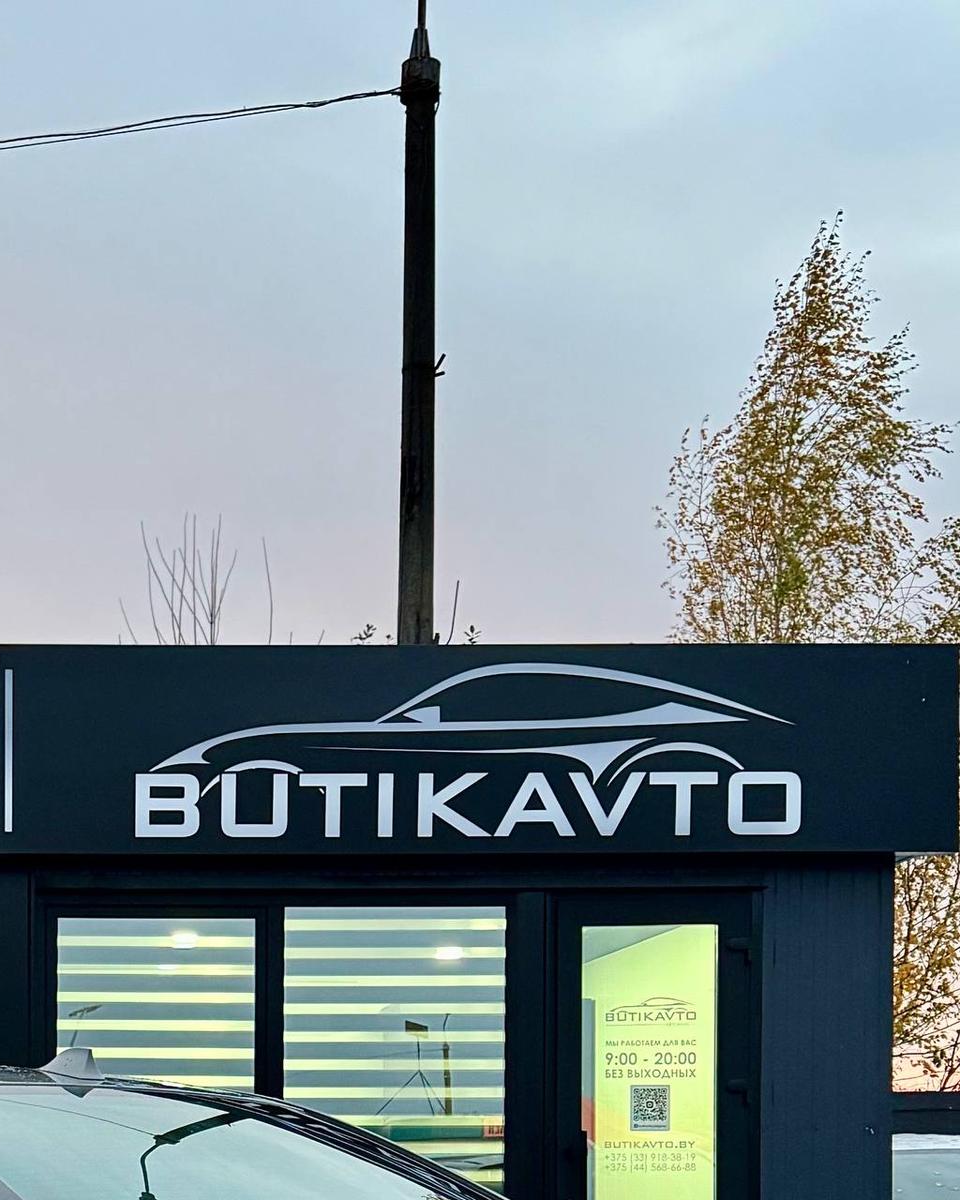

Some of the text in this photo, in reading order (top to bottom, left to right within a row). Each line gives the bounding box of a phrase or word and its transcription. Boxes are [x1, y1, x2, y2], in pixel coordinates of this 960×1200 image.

[135, 771, 802, 838] BUTIKAVTO
[605, 1011, 697, 1022] BUTIKAVTO
[605, 1052, 638, 1065] 9:00
[654, 1052, 697, 1065] 20:00
[605, 1068, 696, 1079] БЕЗ ВЫХОДНЫХ
[604, 1141, 696, 1149] BUTIKAVTO.BY
[604, 1153, 627, 1162] +375
[630, 1153, 647, 1163] (33)
[604, 1163, 627, 1171] +375
[630, 1163, 647, 1173] (44)
